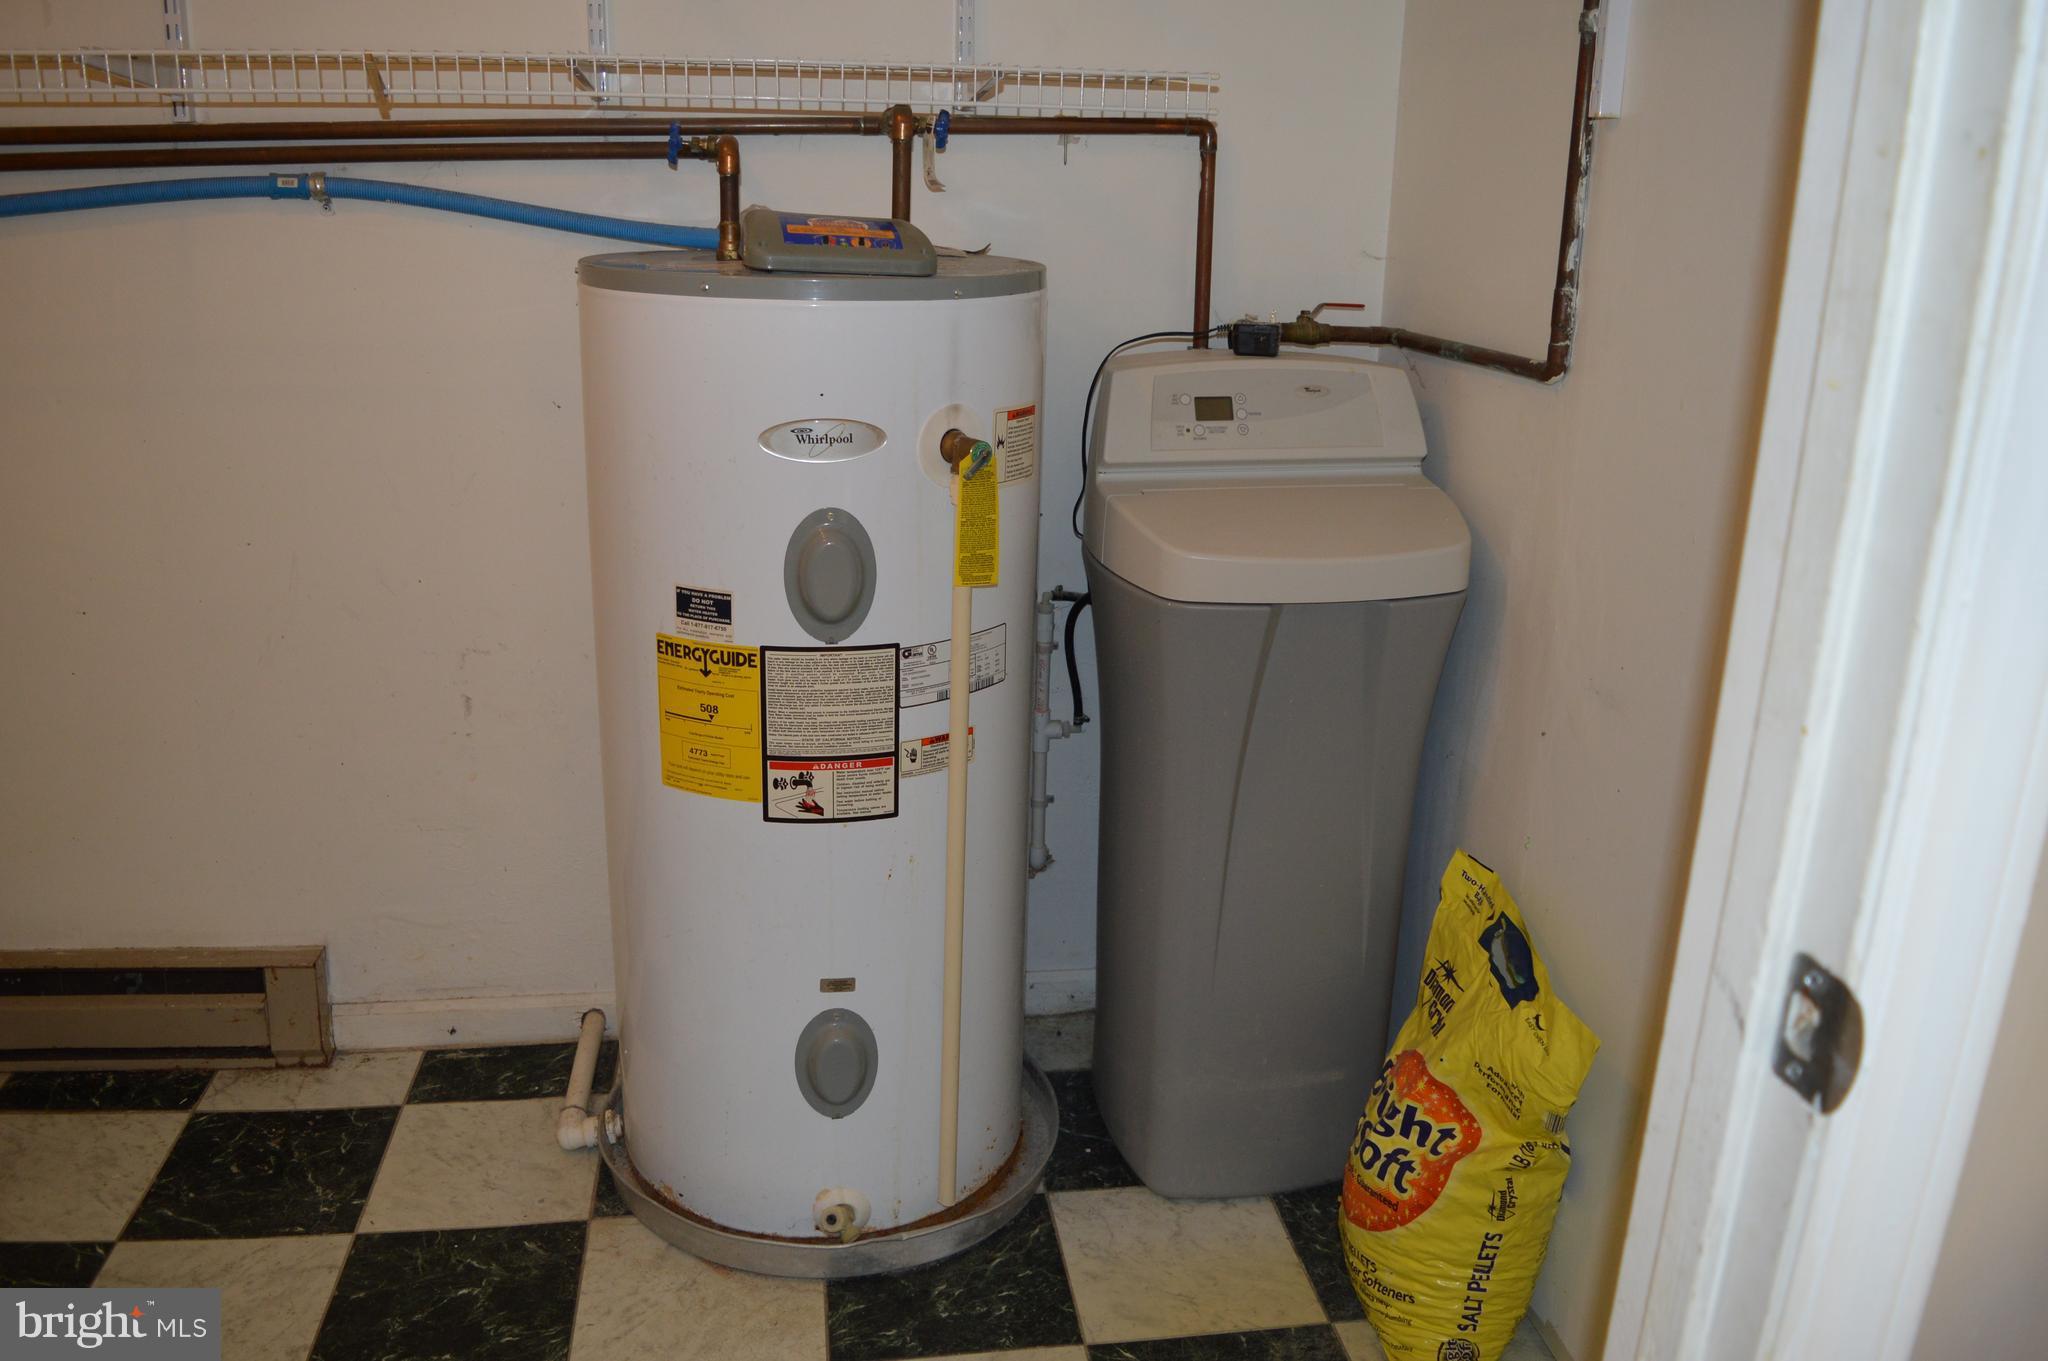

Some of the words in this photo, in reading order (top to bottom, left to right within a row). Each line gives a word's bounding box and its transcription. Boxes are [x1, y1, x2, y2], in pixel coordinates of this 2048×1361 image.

[796, 433, 853, 446] Whirlpool
[657, 639, 757, 668] ENERGYGUIDE
[700, 703, 719, 714] 508
[689, 747, 708, 757] 4773
[1423, 968, 1456, 1014] Diamon
[1357, 1174, 1399, 1212] Guaranteed
[1496, 1190, 1507, 1222] Diamond
[1505, 1176, 1519, 1210] Crystal
[1467, 1232, 1504, 1293] PELLETS
[1362, 1271, 1416, 1304] Softeners
[1457, 1296, 1484, 1333] SALT
